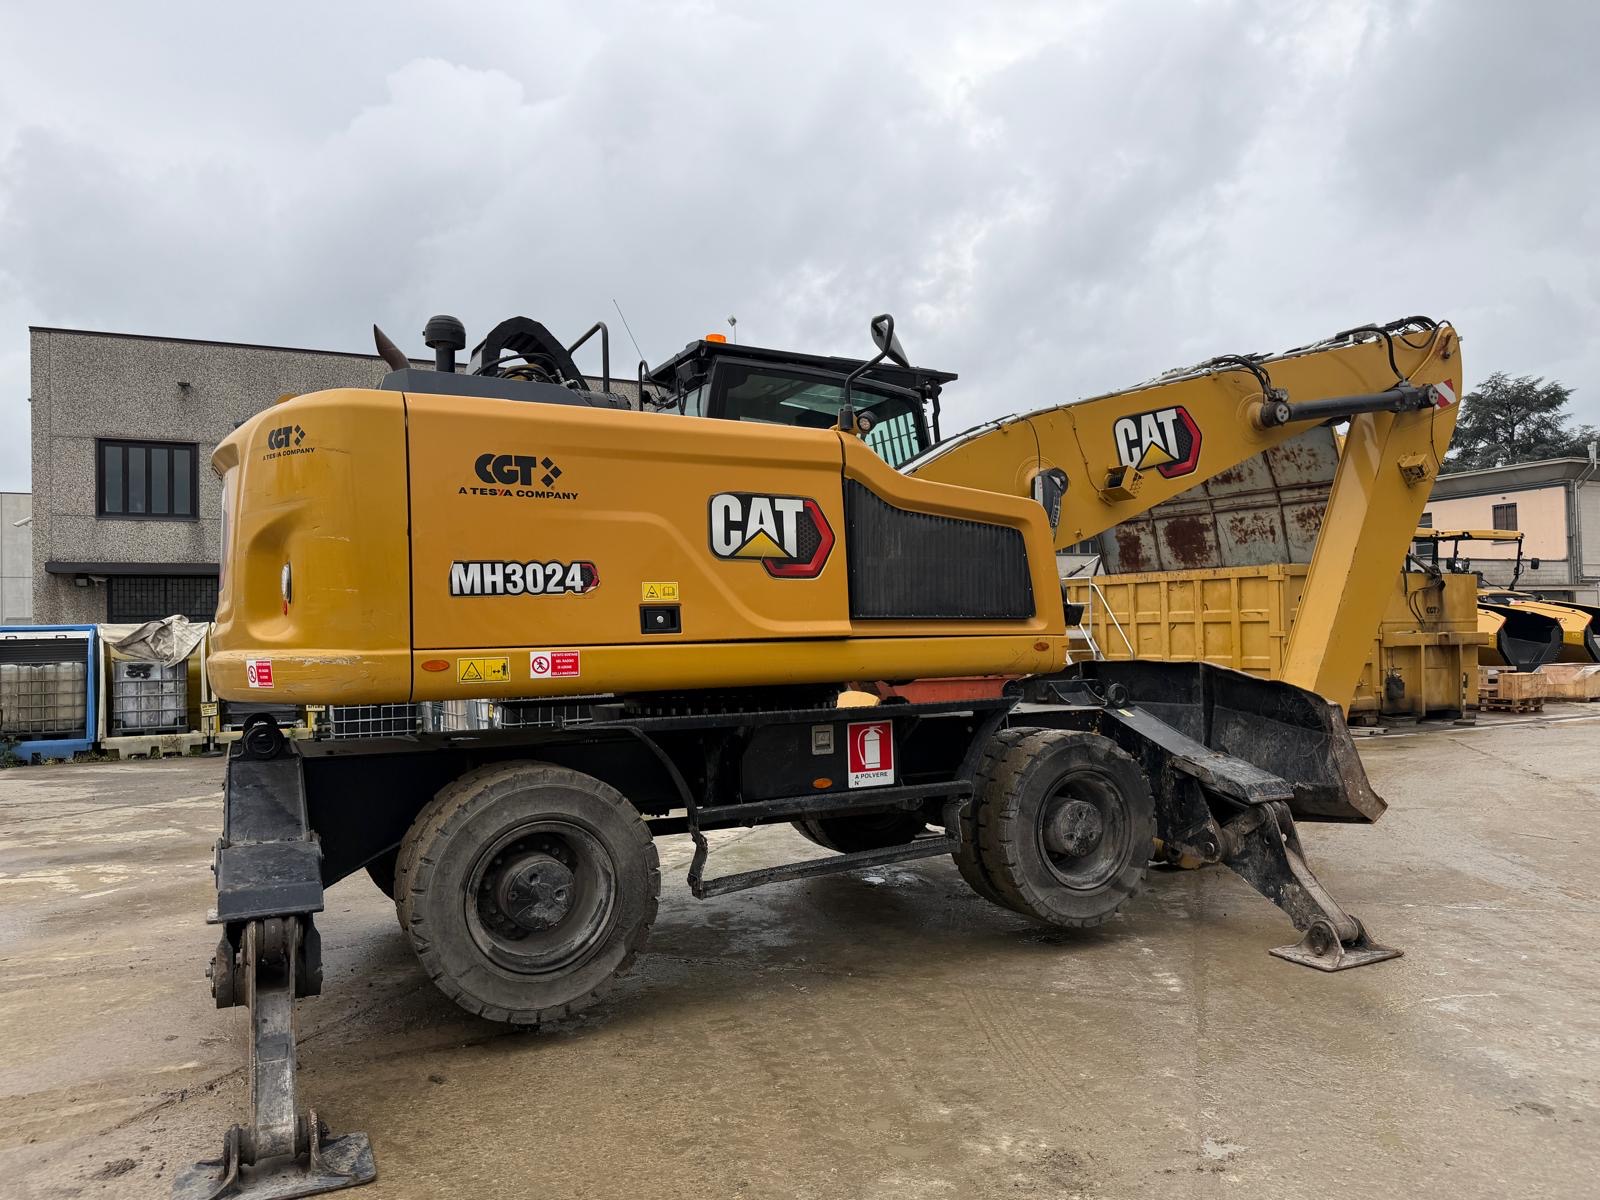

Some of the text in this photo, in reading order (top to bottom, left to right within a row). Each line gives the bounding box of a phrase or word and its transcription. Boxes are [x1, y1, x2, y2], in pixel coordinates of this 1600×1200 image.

[268, 426, 292, 450] CGT
[282, 448, 315, 456] COMPANY
[1115, 408, 1179, 469] CAT
[475, 453, 537, 486] CGT
[516, 490, 579, 500] COMPANY
[711, 494, 804, 558] CAT
[451, 562, 584, 595] MH3024
[860, 771, 888, 779] POLVERE
